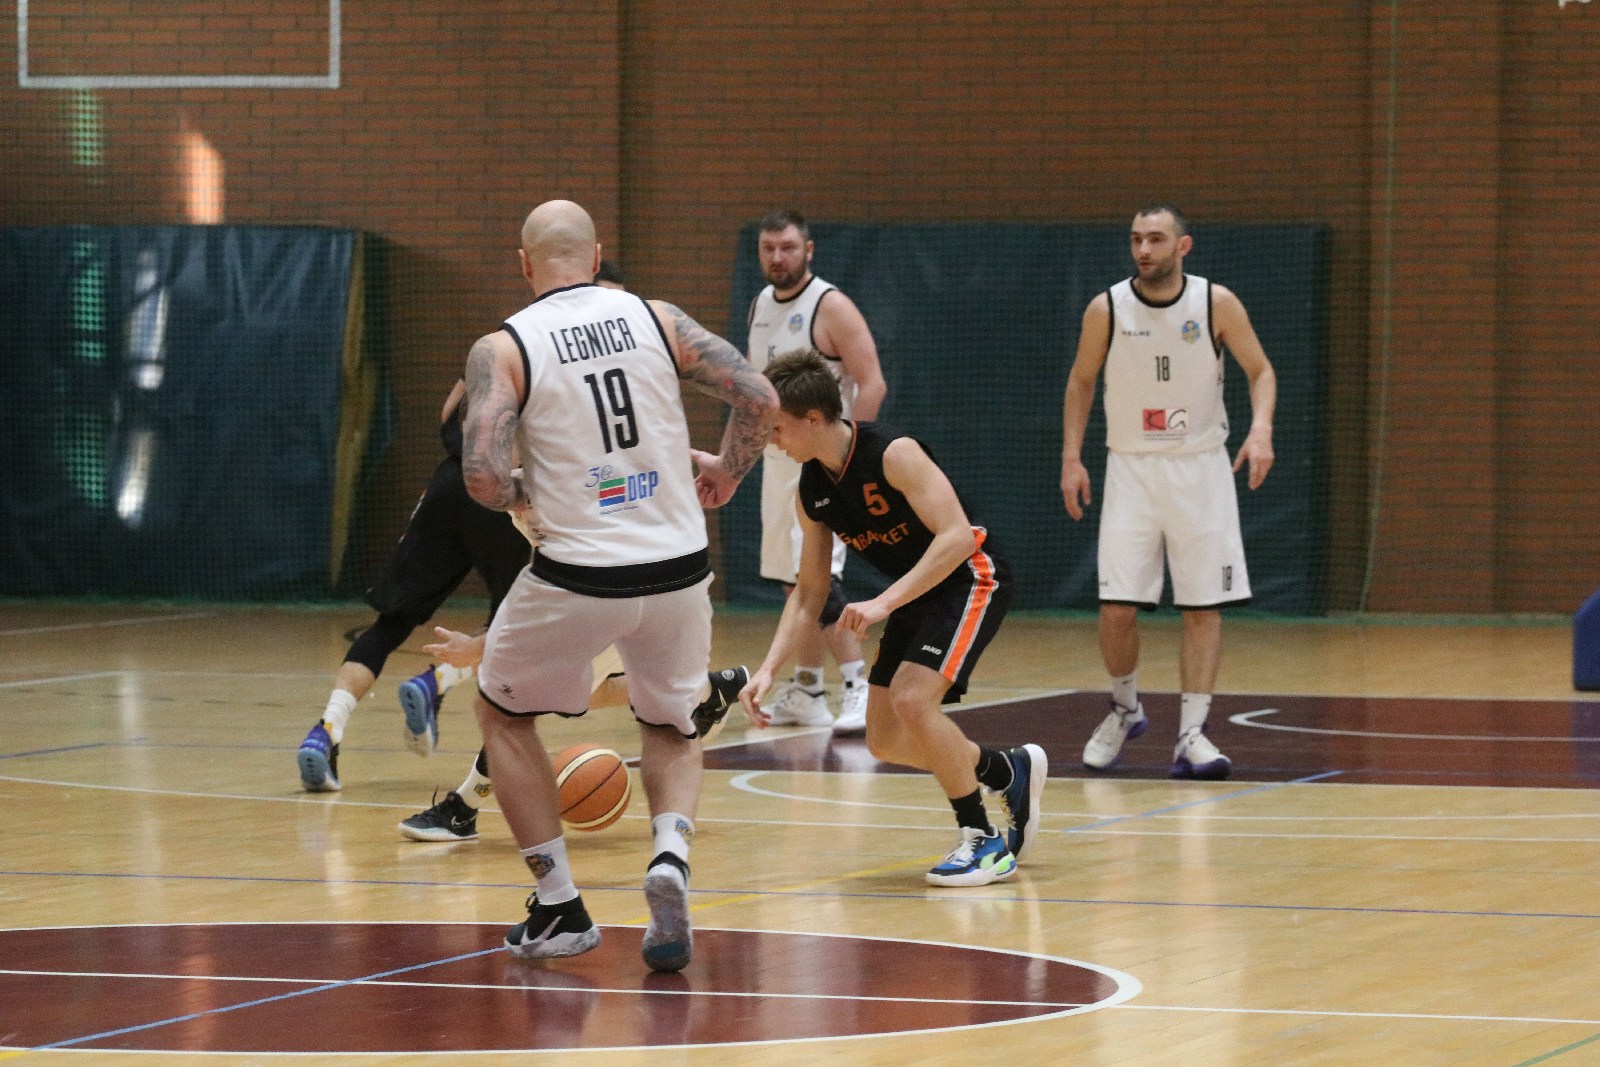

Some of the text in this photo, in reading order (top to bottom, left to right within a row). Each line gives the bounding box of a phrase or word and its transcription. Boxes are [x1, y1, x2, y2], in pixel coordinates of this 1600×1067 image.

[550, 317, 637, 364] LEGNICA
[1155, 356, 1170, 381] 18
[584, 368, 638, 454] 19
[628, 471, 658, 501] DGP
[863, 483, 890, 516] 5
